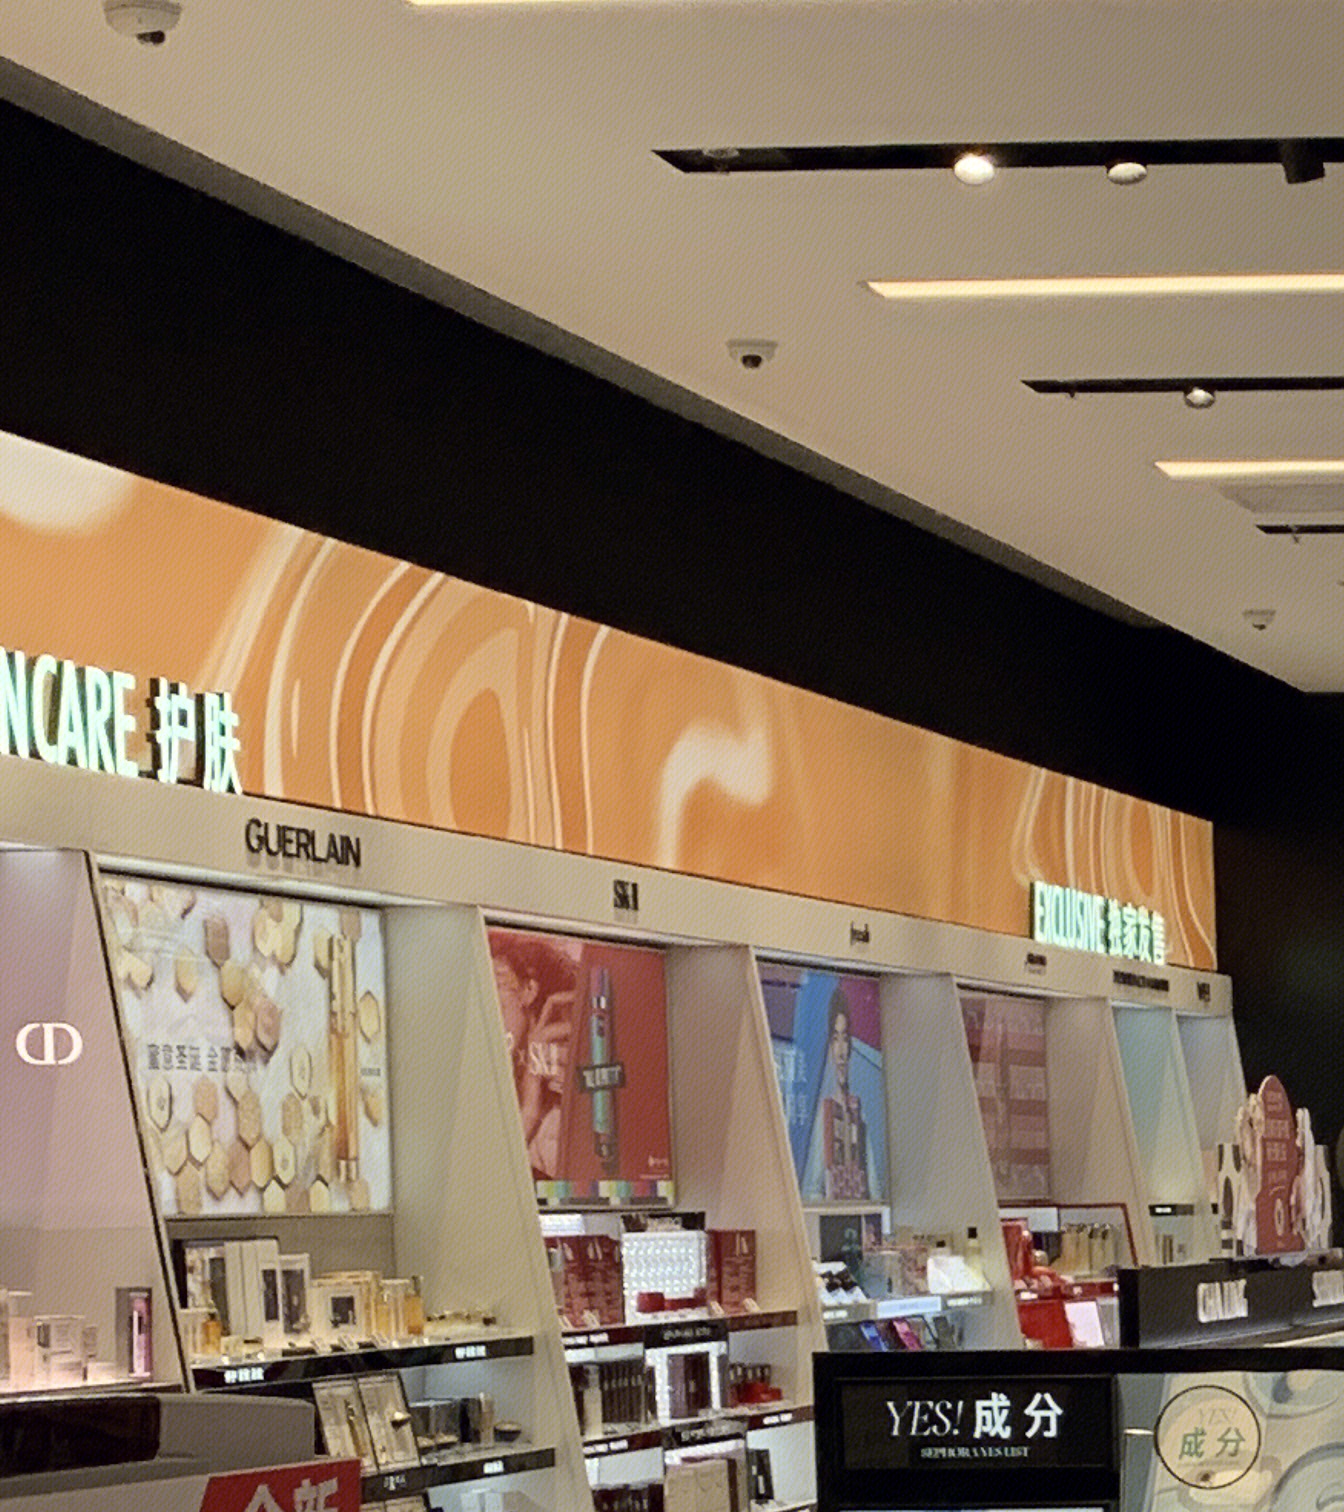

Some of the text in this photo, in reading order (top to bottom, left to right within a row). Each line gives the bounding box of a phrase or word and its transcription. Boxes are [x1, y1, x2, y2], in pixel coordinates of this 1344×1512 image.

[155, 676, 243, 795] 护肤
[244, 817, 361, 868] GUERLAIN
[1034, 880, 1105, 954] EXCLUSIVE
[887, 1391, 1064, 1440] YES! 成分
[1178, 1426, 1246, 1461] 成分
